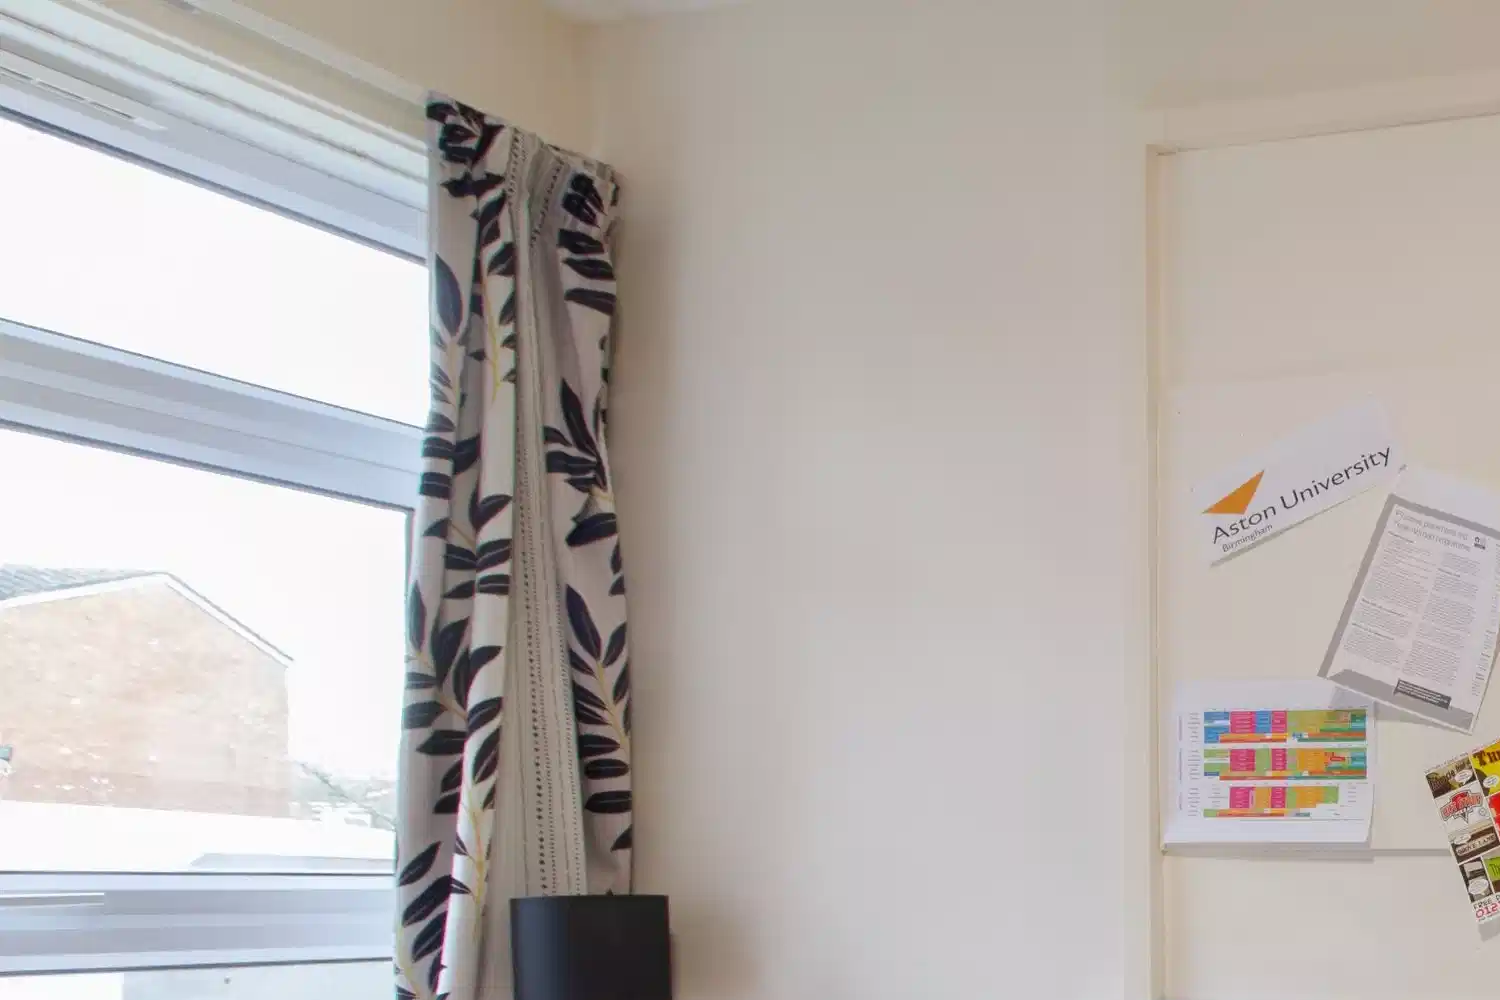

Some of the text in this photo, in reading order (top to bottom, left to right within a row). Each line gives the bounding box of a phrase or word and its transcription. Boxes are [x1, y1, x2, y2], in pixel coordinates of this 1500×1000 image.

[1211, 446, 1393, 545] Aston University
[1221, 523, 1274, 553] Birmingham
